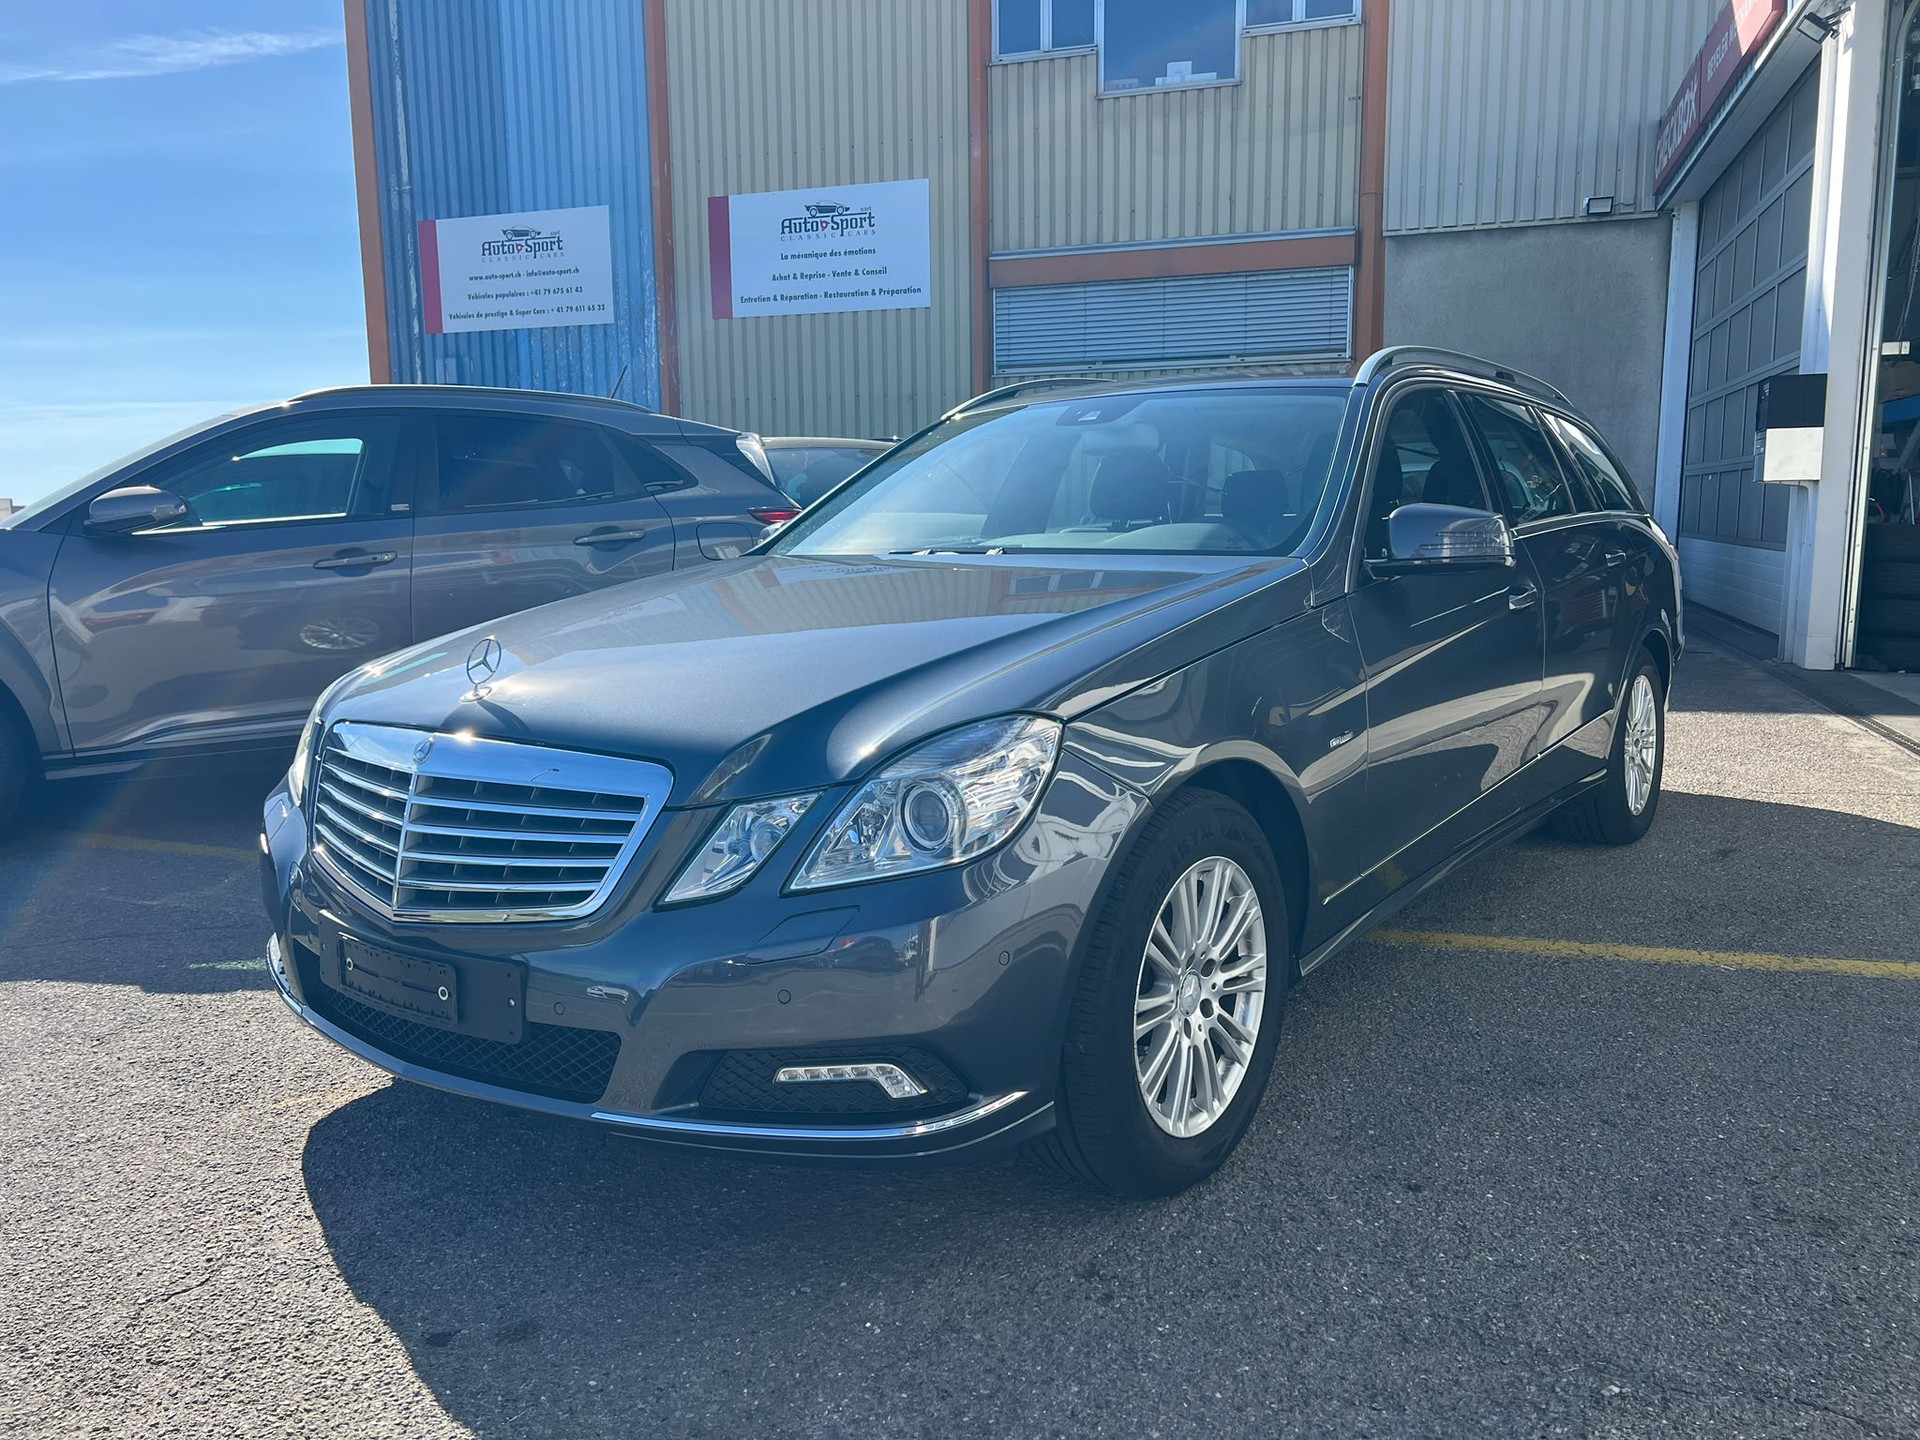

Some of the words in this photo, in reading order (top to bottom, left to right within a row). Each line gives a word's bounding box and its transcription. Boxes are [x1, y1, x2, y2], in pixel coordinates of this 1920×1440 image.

[780, 232, 836, 242] CLASSIC
[847, 229, 876, 237] CARS
[481, 255, 531, 263] CLASSIC
[790, 250, 828, 260] mécanique
[829, 249, 842, 257] des
[843, 247, 876, 256] émotions
[771, 273, 791, 281] Achat
[799, 271, 826, 281] Reprise
[832, 270, 852, 278] Vente
[854, 268, 860, 276] &
[861, 266, 887, 276] Conseil
[495, 290, 525, 300] populaires
[740, 295, 771, 304] Entretien
[772, 294, 778, 302] &
[780, 292, 819, 303] Réparation
[823, 289, 869, 299] Restauration
[870, 288, 877, 296] &
[878, 286, 922, 297] Préparation
[476, 311, 483, 319] de
[485, 310, 508, 320] prestige
[515, 309, 532, 318] Super
[587, 304, 596, 312] 65
